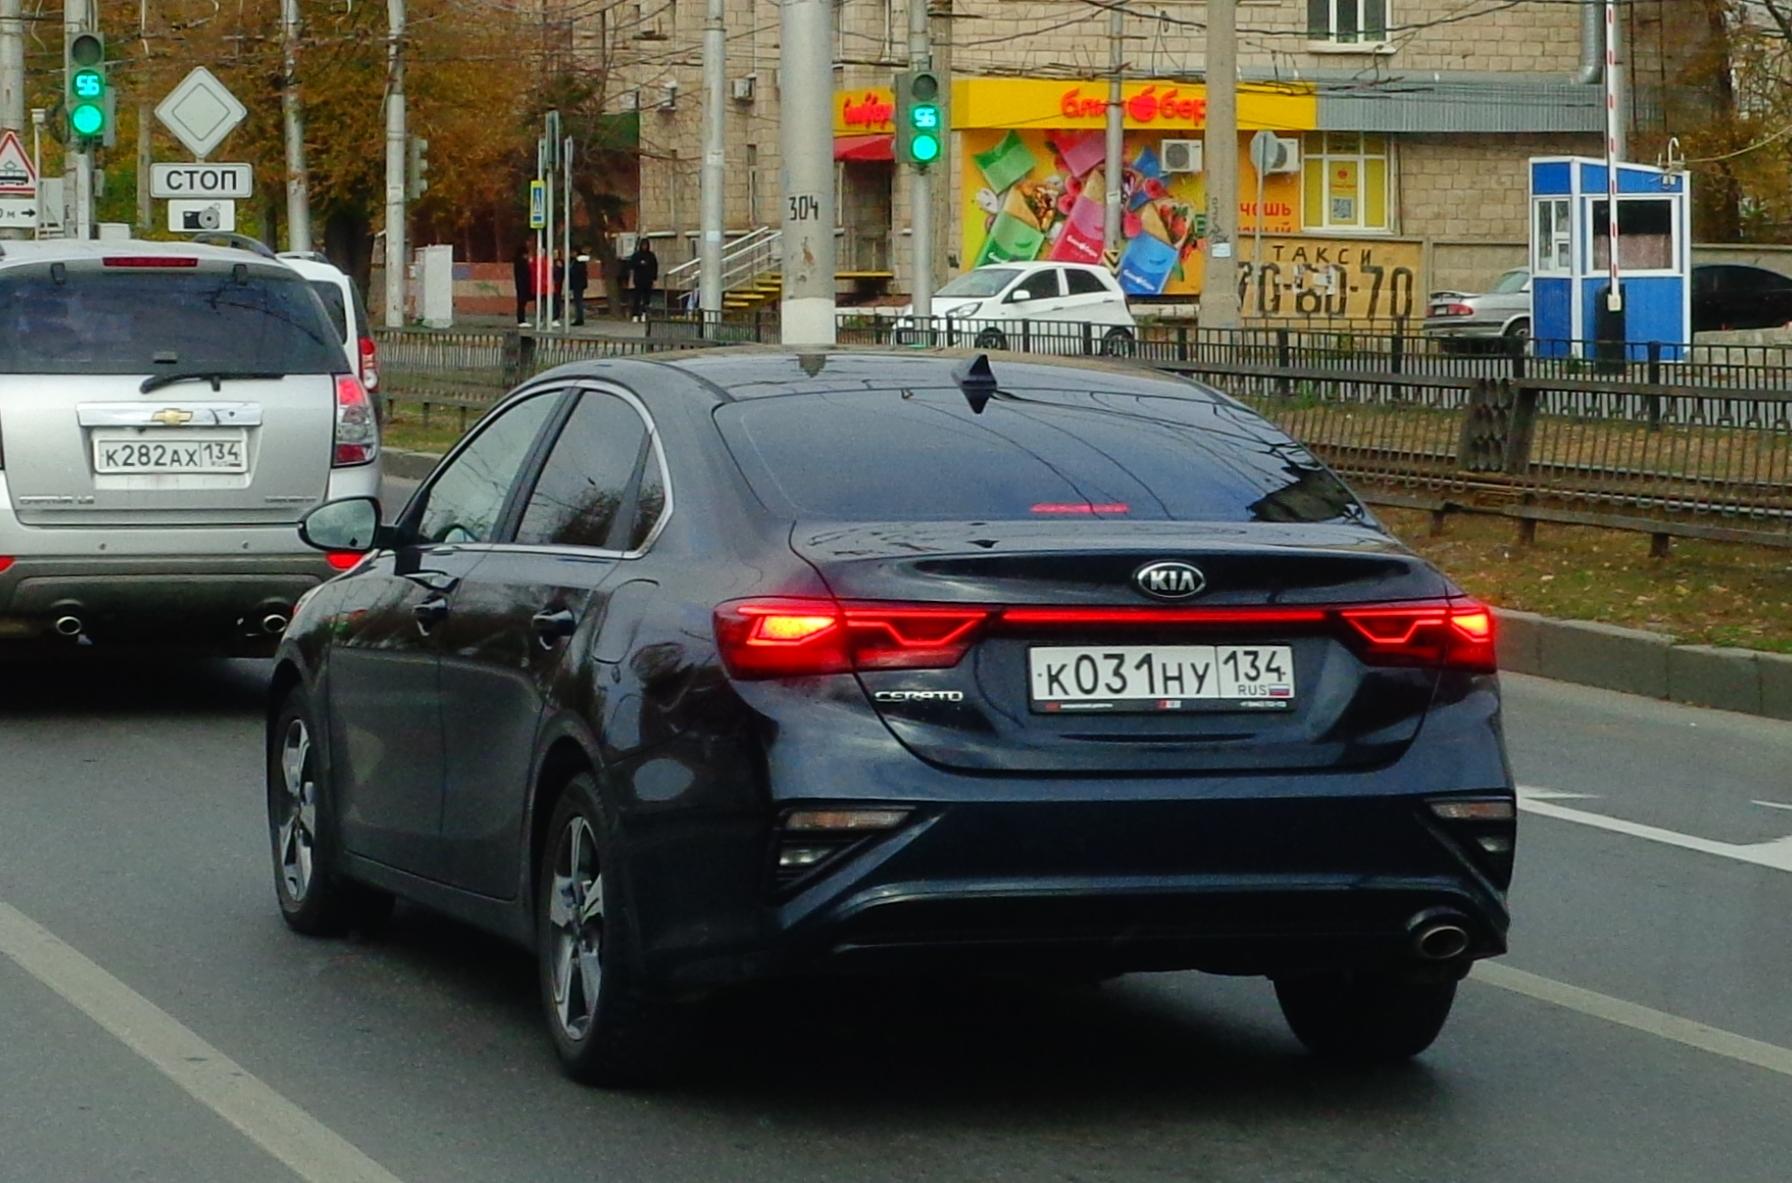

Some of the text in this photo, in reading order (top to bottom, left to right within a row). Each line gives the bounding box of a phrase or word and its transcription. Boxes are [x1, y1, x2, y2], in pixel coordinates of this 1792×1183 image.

[75, 75, 100, 96] 56
[914, 107, 937, 127] 56
[166, 170, 237, 191] СТОП
[788, 194, 818, 221] 304
[1273, 245, 1371, 265] ТАКСИ
[106, 443, 238, 468] К282АХ 134
[1149, 569, 1196, 591] KIA
[1046, 650, 1285, 696] К031НУ 134
[1238, 684, 1268, 697] RUS
